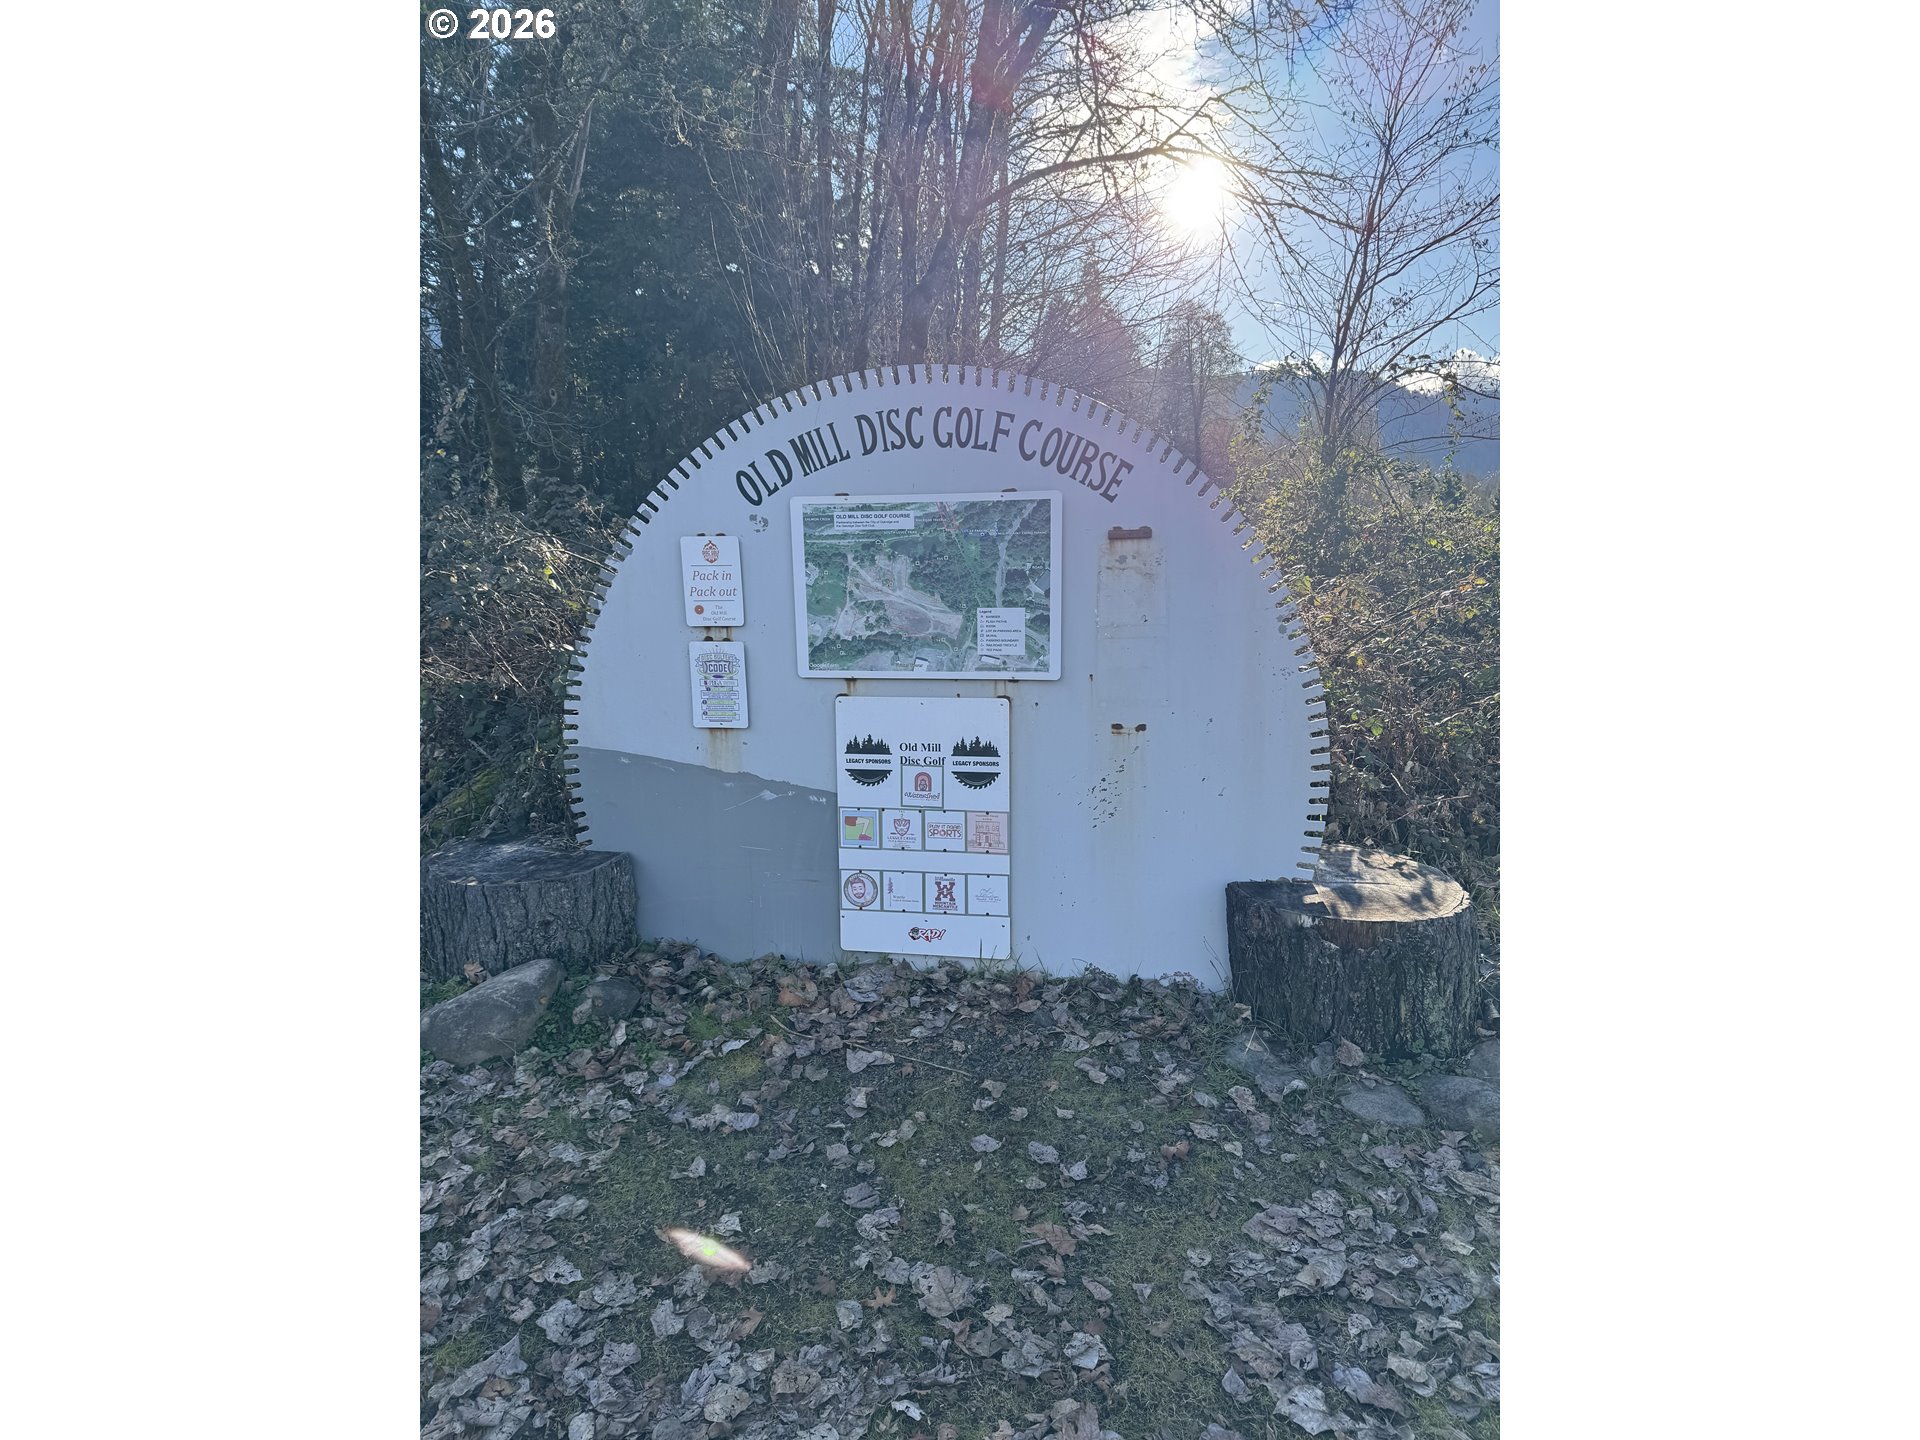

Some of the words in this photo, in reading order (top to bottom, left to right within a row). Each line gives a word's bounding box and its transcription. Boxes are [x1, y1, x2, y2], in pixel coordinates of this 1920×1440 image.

[736, 449, 793, 506] OLD
[788, 422, 851, 477] MILL
[854, 406, 924, 457] DISC
[932, 406, 1016, 453] GOLF
[1018, 419, 1134, 503] COURSE
[692, 570, 718, 580] Pack
[722, 570, 732, 580] in
[690, 586, 716, 597] Pack
[719, 587, 737, 597] out
[708, 664, 727, 672] CODE
[900, 742, 918, 752] Old
[920, 743, 941, 752] Mill
[900, 756, 921, 765] Disc
[923, 756, 946, 766] Golf
[929, 829, 962, 838] SPORTS
